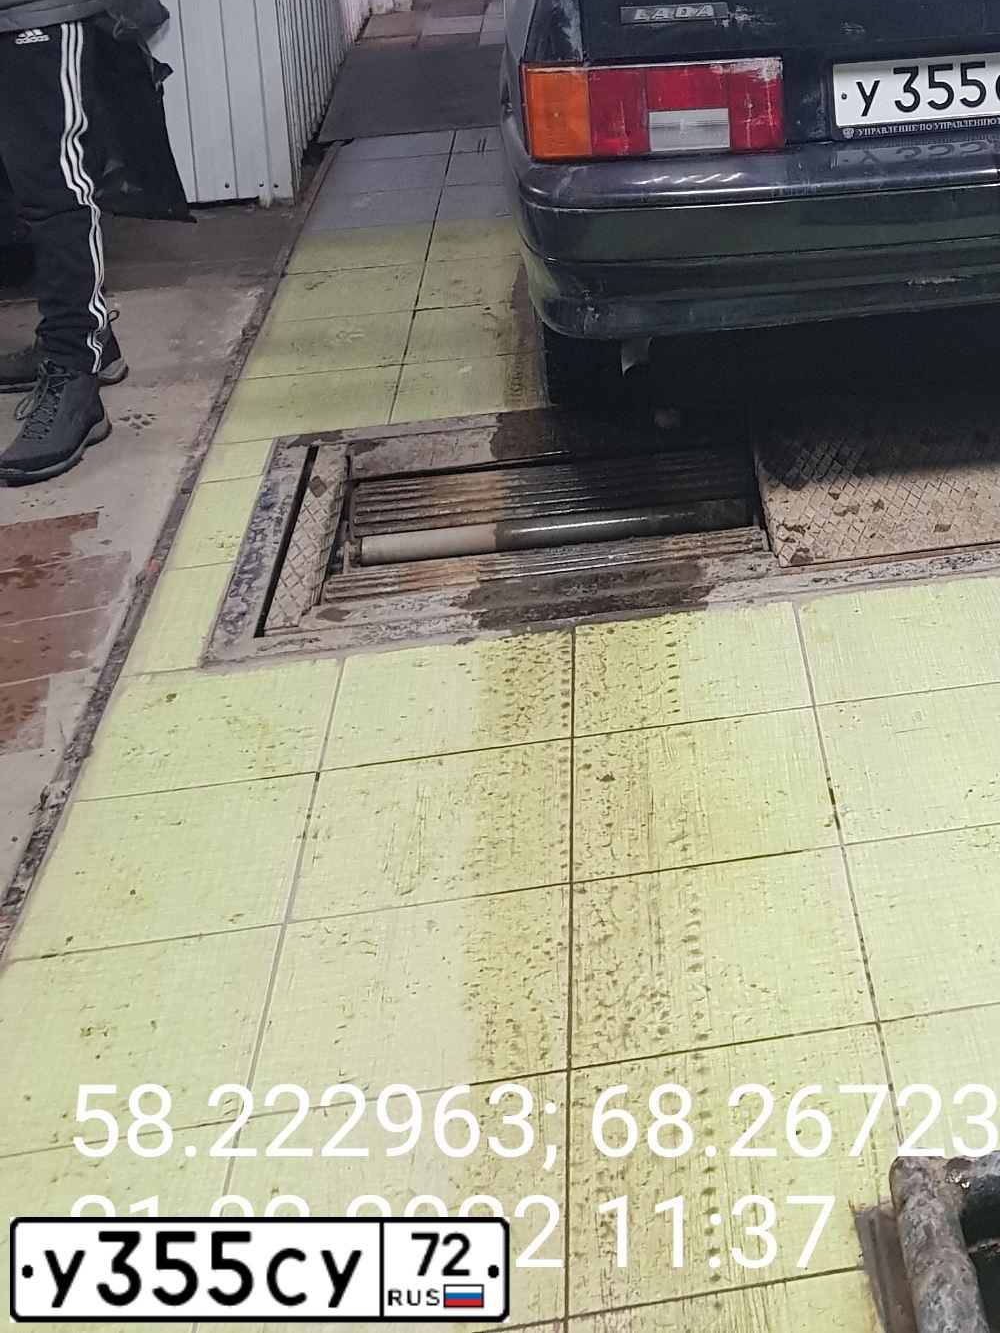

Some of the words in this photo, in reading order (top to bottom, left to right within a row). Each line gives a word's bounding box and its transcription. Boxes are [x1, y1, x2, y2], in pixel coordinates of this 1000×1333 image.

[634, 5, 714, 20] LADA
[15, 34, 50, 45] adidas
[858, 123, 918, 136] УПРАВЛЕНИЕ
[920, 122, 933, 131] ПО
[933, 116, 997, 130] УПРАВЛЕНИЮ
